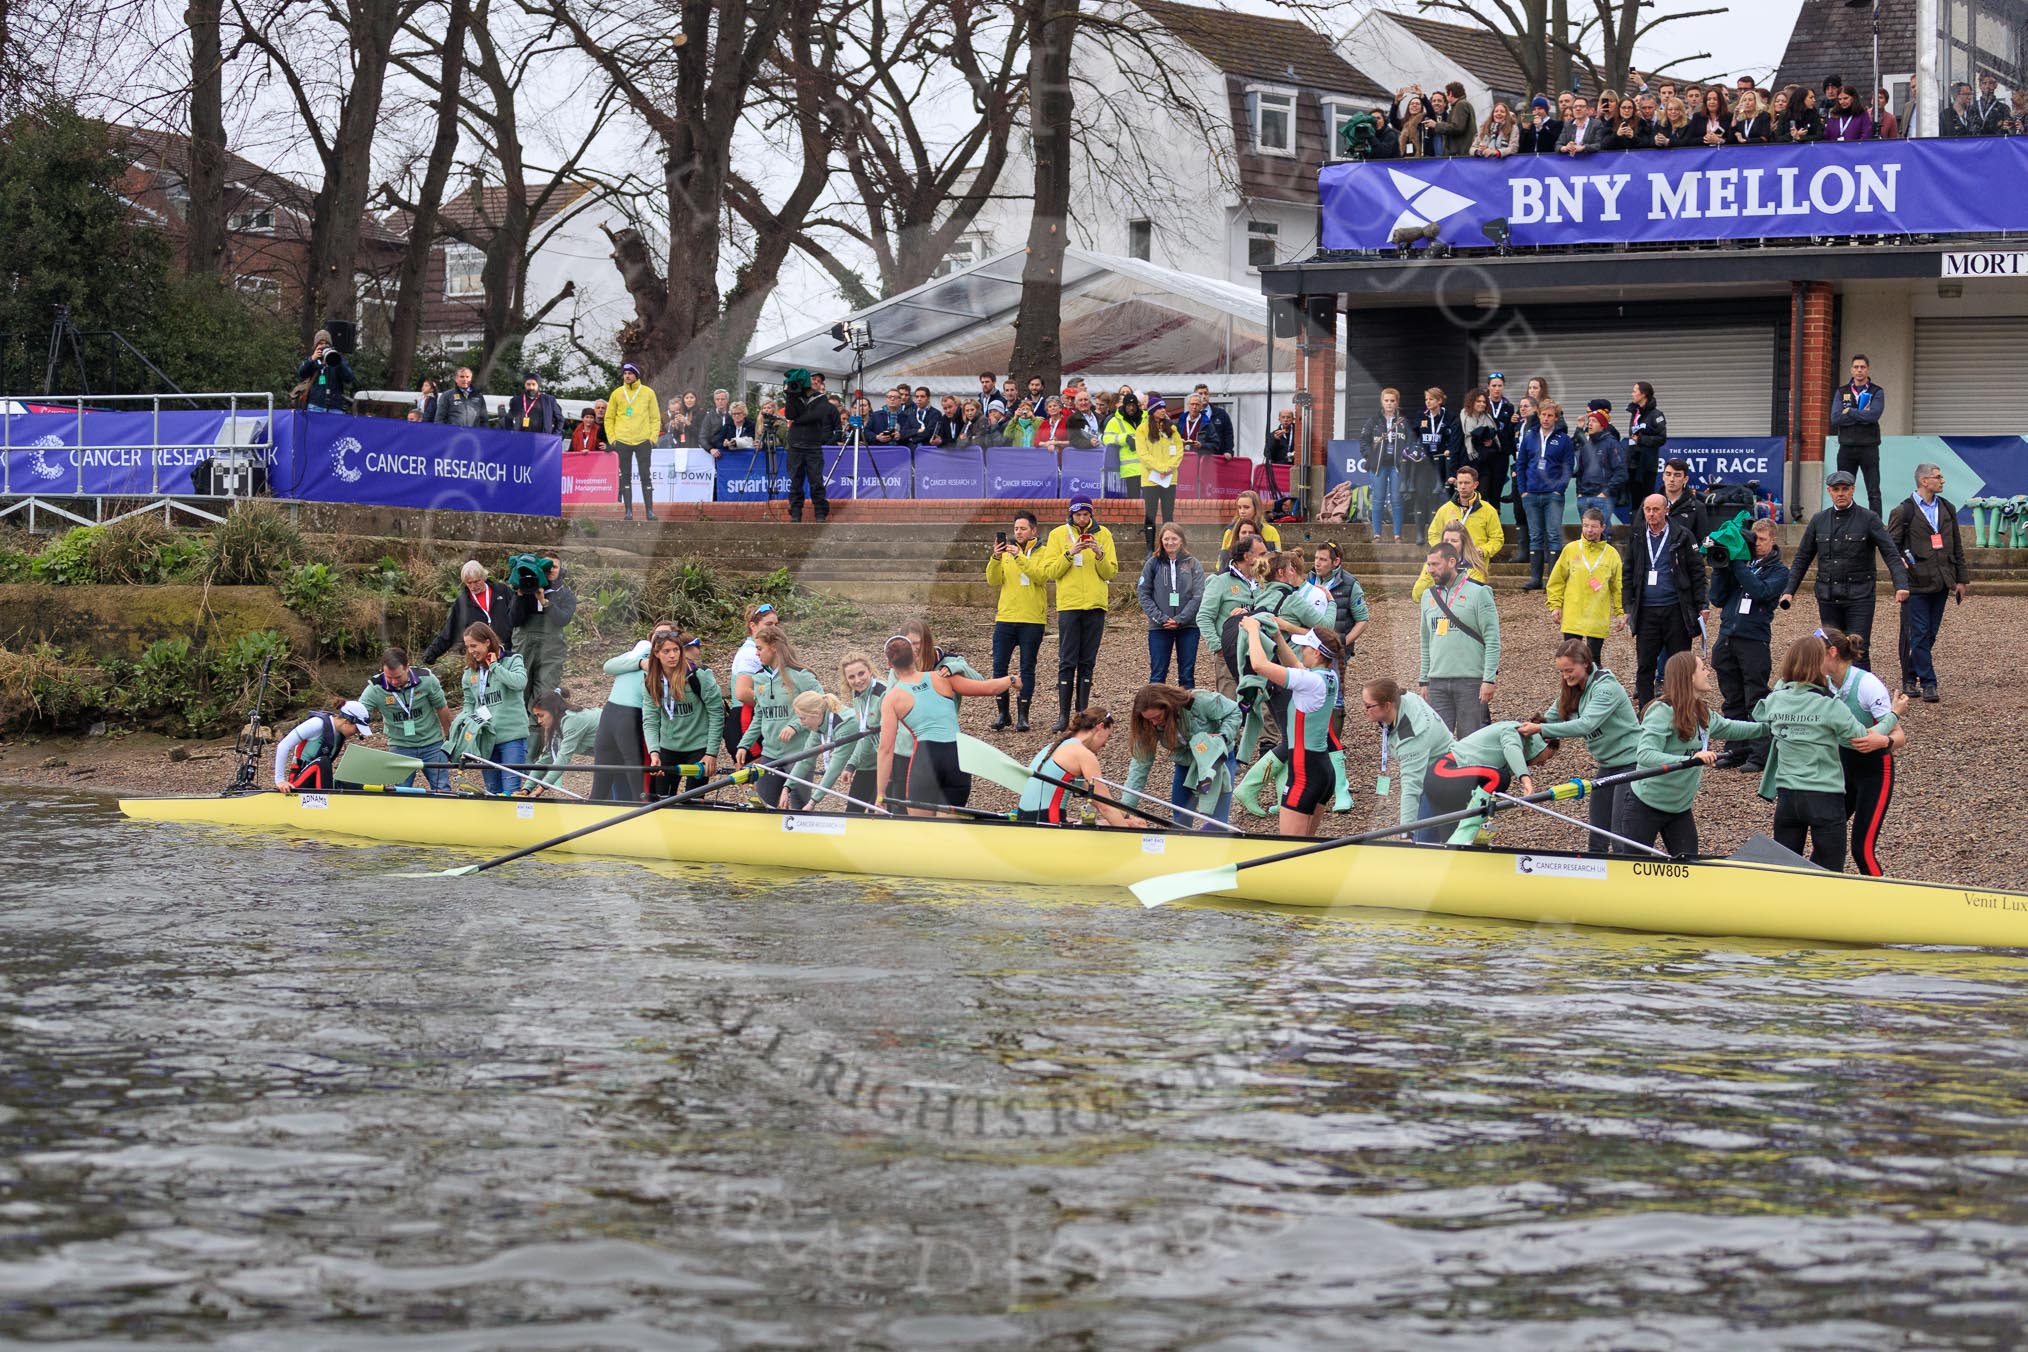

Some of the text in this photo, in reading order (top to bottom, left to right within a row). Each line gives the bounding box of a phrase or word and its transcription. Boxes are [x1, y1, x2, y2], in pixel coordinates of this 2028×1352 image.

[1507, 163, 1902, 225] BNY MELLON
[1946, 253, 2028, 275] MORT
[365, 452, 532, 485] CANCER RESEARCH UK
[1657, 457, 1769, 473] BAT RACE
[681, 471, 712, 481] DOWN
[930, 478, 946, 487] CANCER
[947, 478, 970, 487] RESEARCH
[575, 485, 612, 493] Management
[1021, 480, 1043, 488] RESEARCH
[761, 704, 789, 719] NEWTON
[1768, 712, 1821, 722] CAMBRIDGE
[301, 793, 328, 806] ADNAMS
[1536, 861, 1562, 871] CANCER
[1563, 864, 1596, 873] RESEARCH
[1632, 862, 1689, 878] CUW805
[1964, 892, 2028, 912] Venit Lux
